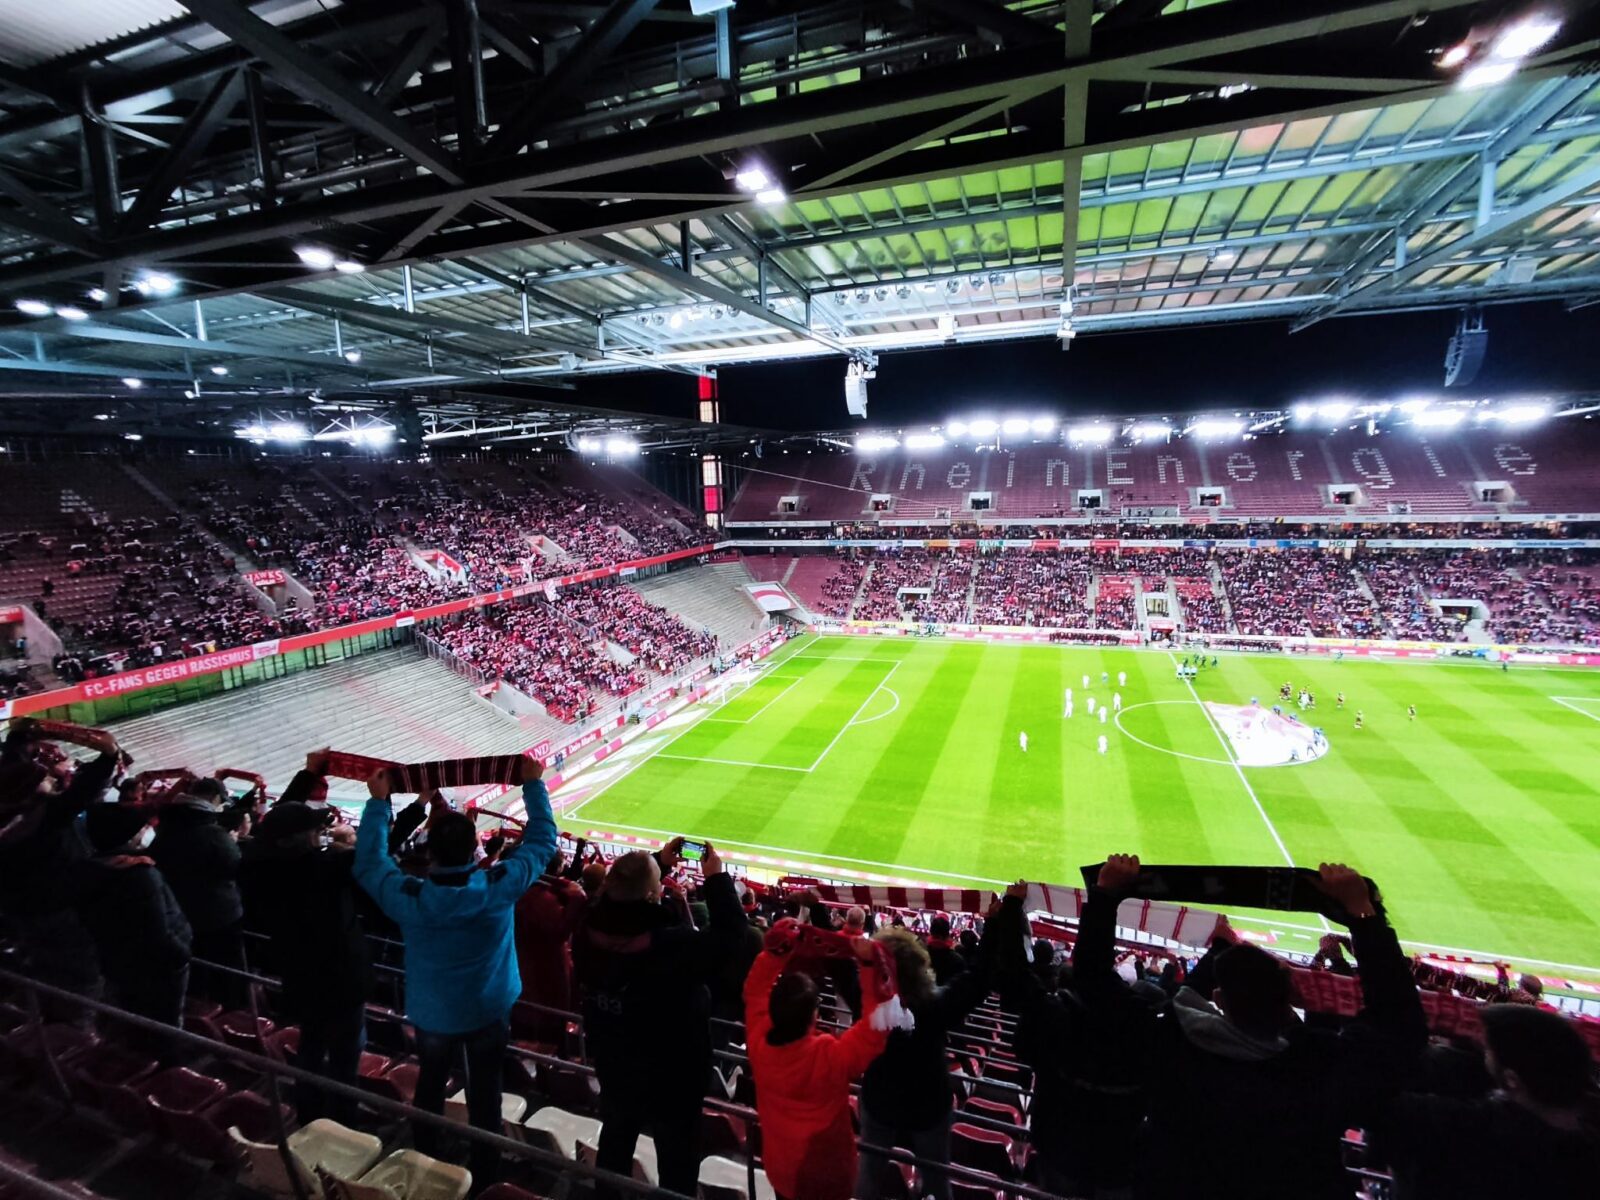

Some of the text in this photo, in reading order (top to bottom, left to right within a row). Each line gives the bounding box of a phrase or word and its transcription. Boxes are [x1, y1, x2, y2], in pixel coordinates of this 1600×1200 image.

[84, 674, 144, 698] FC-FANS
[146, 663, 188, 684] GEGEN
[190, 649, 253, 674] RASSISMUS
[545, 748, 568, 768] REE
[475, 785, 503, 808] REWE
